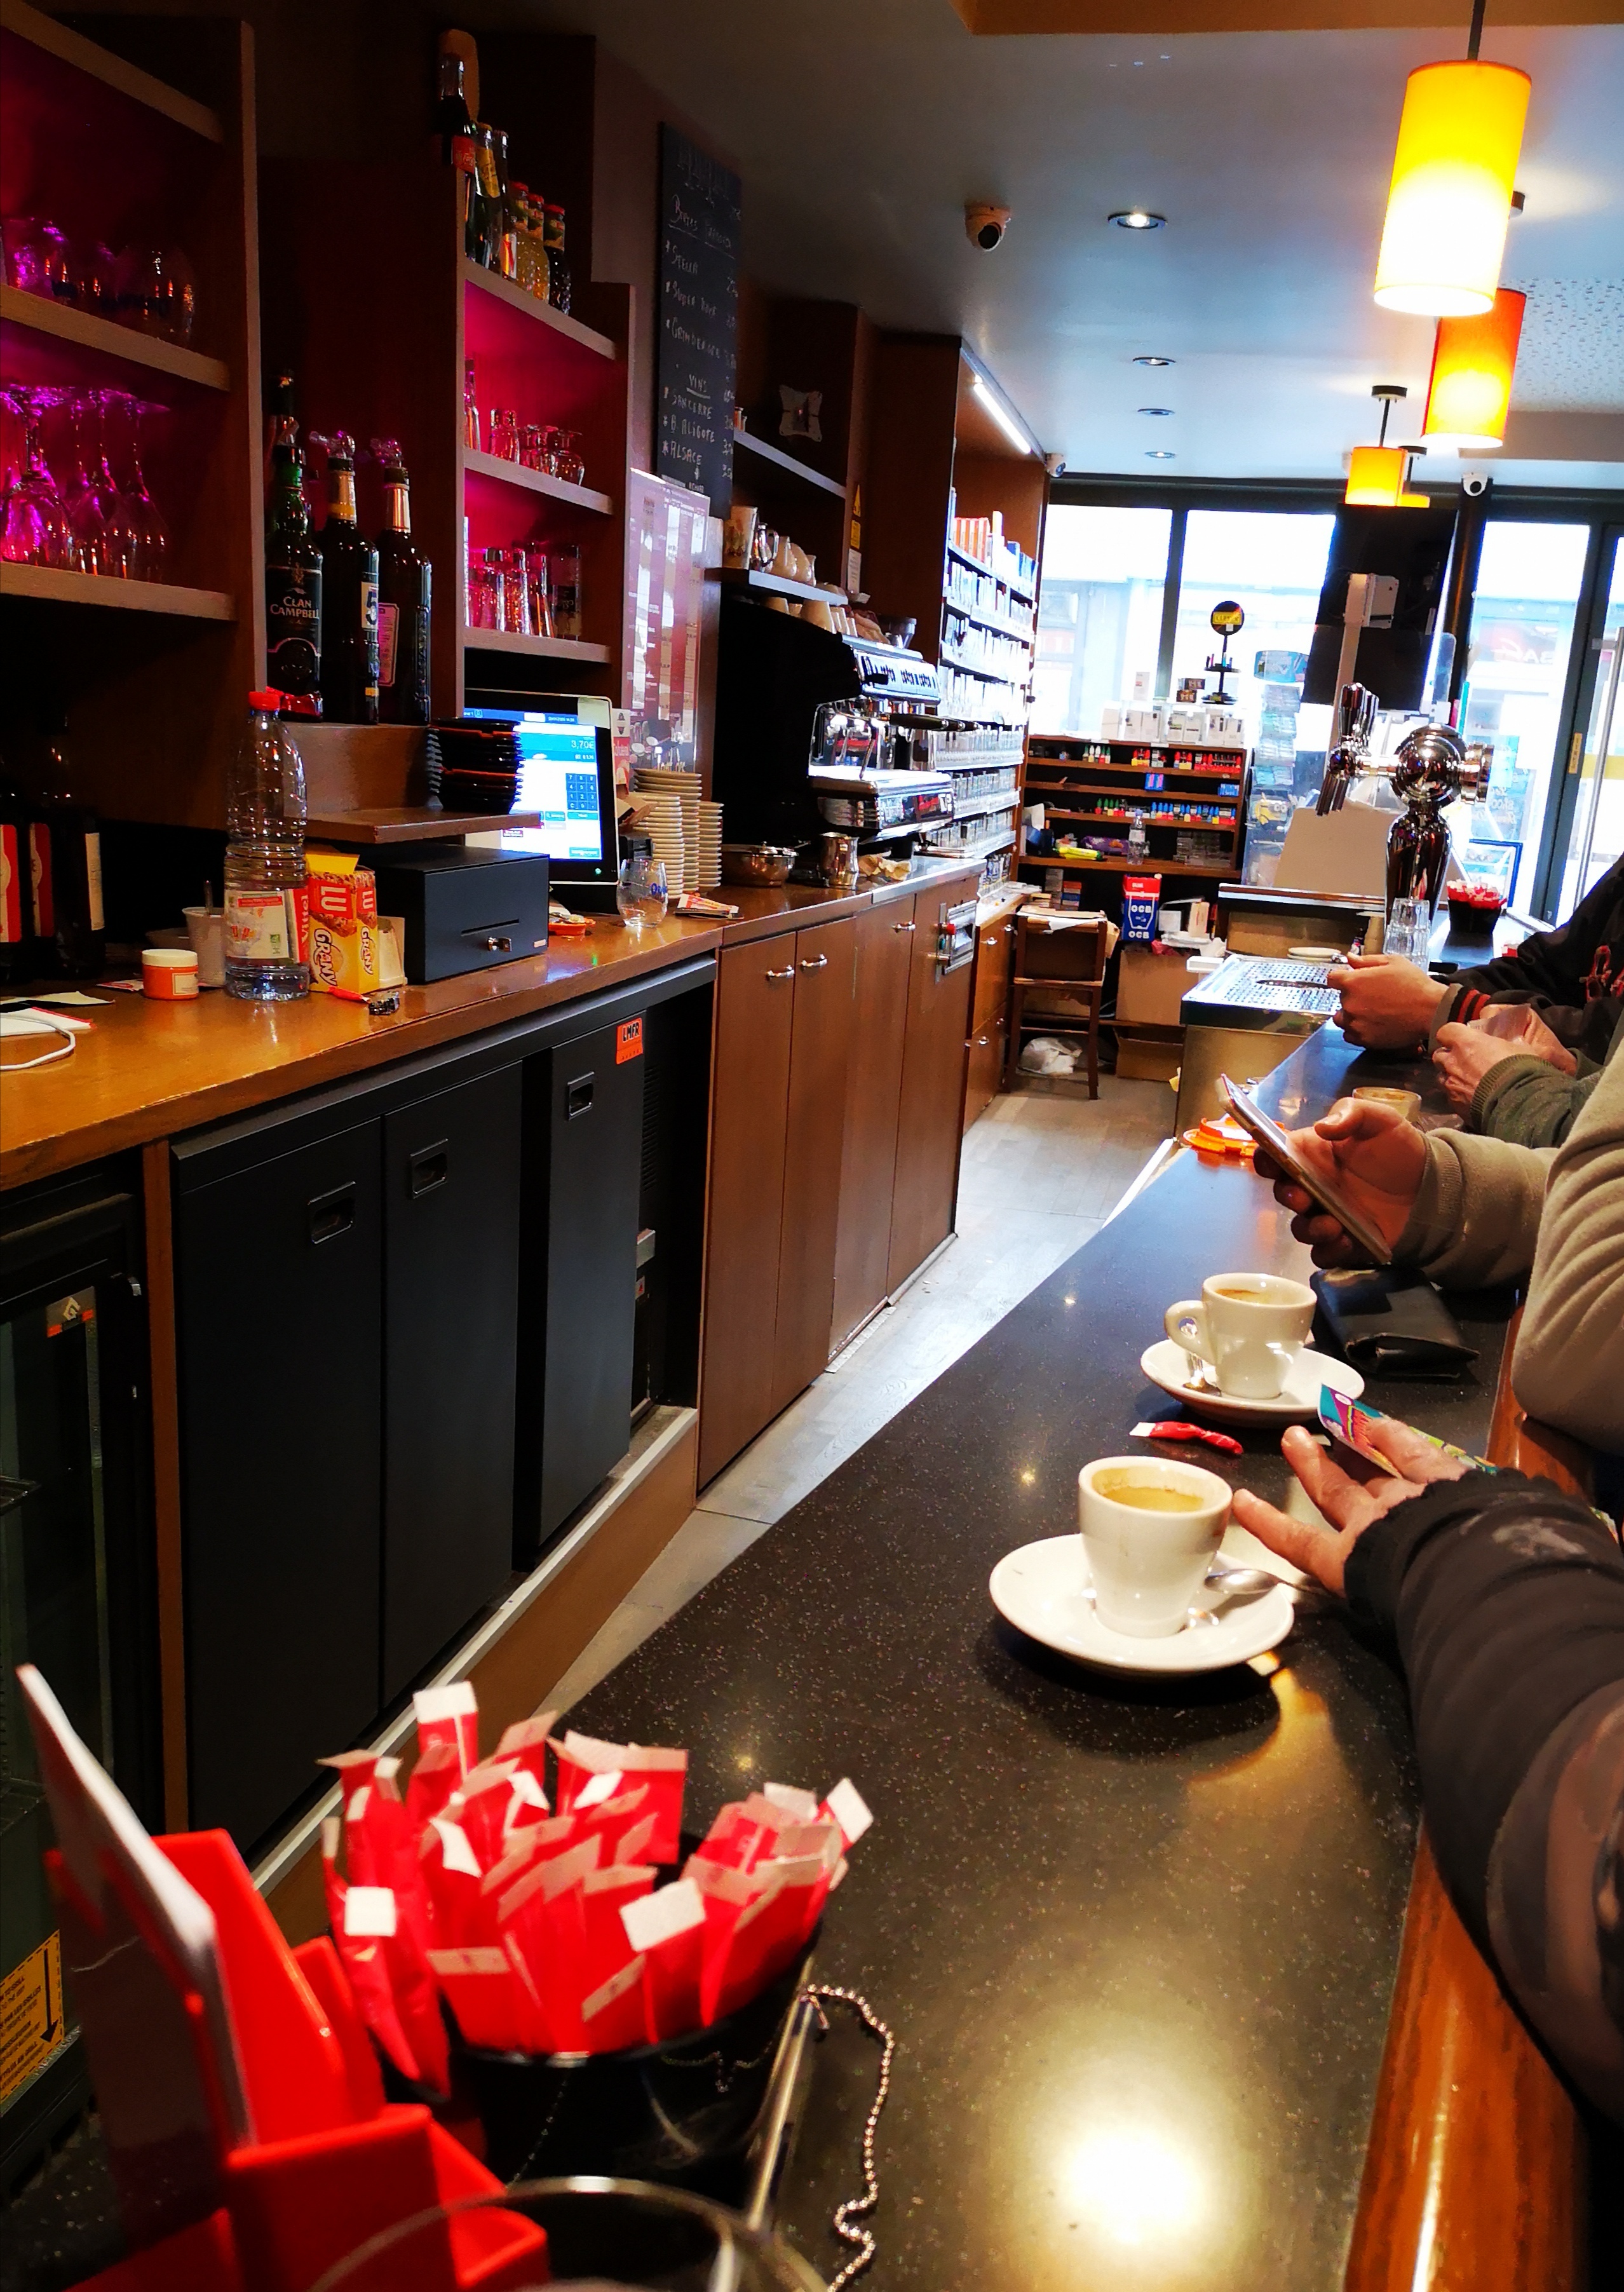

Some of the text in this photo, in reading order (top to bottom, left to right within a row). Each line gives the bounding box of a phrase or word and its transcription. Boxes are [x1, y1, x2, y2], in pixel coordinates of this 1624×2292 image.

[670, 440, 701, 465] ALSACE
[283, 596, 312, 609] CLAN
[571, 740, 595, 749] 3,70€
[320, 886, 348, 912] LU
[362, 890, 374, 909] LU
[1131, 904, 1152, 913] OCB
[301, 894, 309, 944] Vittel
[1128, 930, 1149, 939] OCB
[313, 928, 338, 986] GRANY
[360, 926, 374, 975] GRANY
